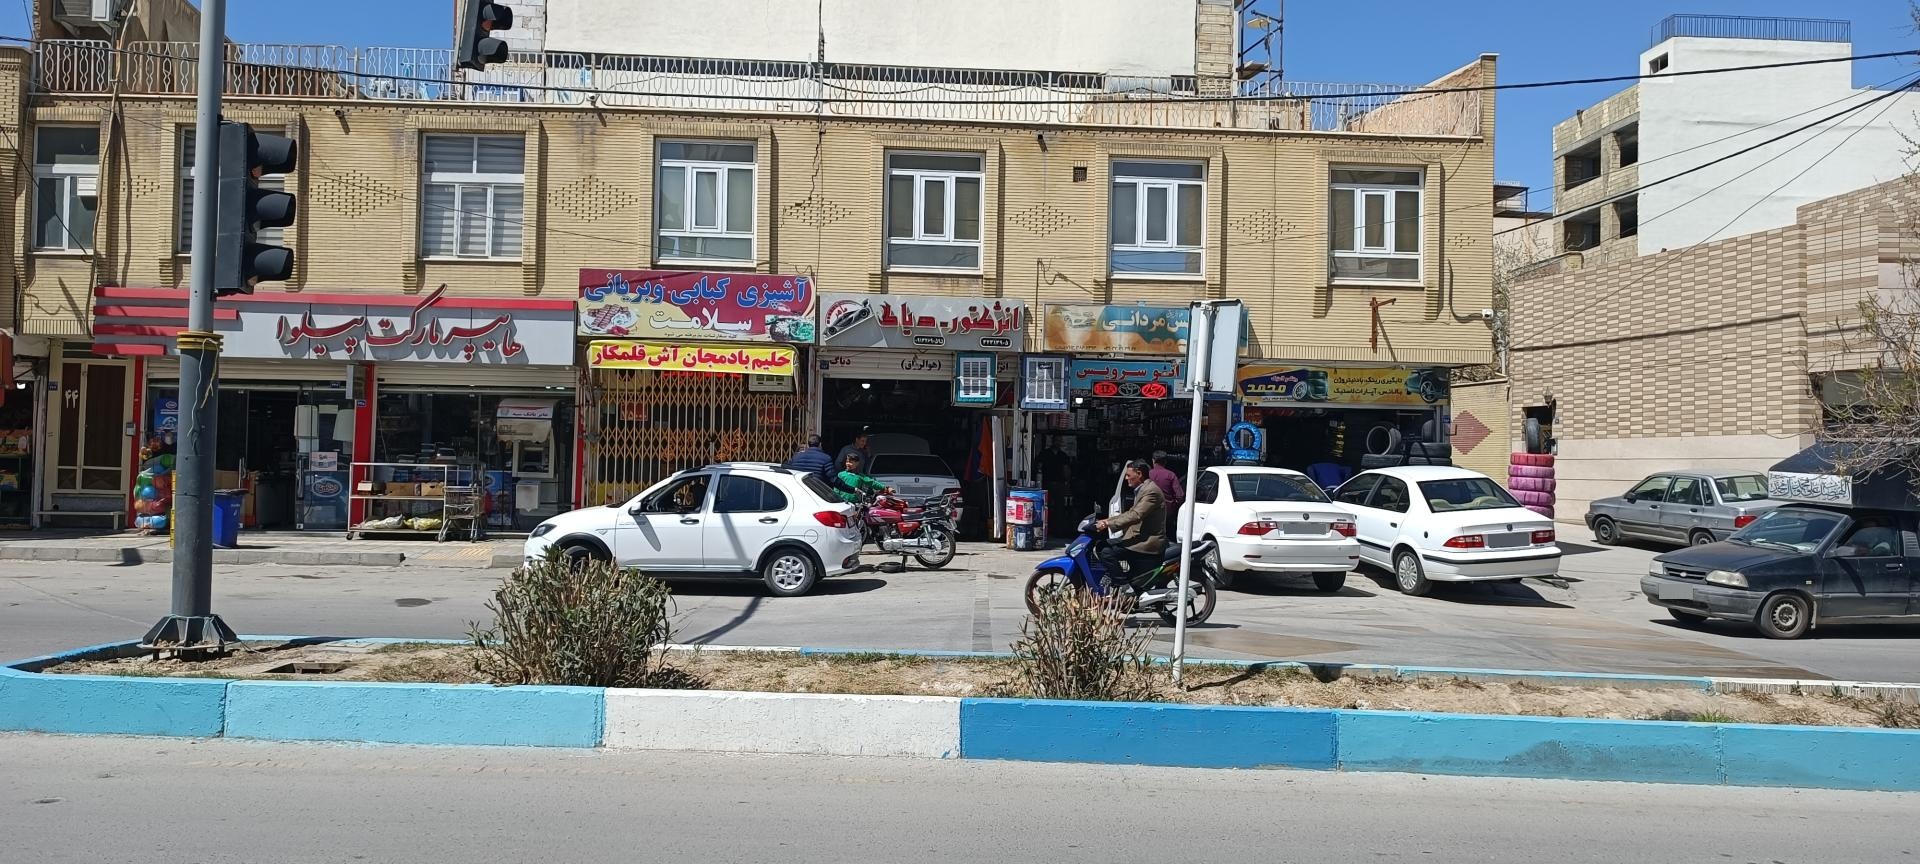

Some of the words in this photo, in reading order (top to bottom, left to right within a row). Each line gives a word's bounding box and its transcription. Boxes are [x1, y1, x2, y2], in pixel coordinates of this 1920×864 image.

[671, 276, 731, 305] کبابی
[737, 277, 809, 309] آشپزی
[365, 283, 447, 347] مارکت
[648, 307, 752, 331] سلامت
[879, 301, 937, 335] دیاگ
[949, 301, 1021, 335] انژکتور
[1102, 311, 1166, 332] مردانی
[592, 345, 647, 365] قلمکار
[648, 345, 680, 368] آش
[683, 348, 751, 370] بادمجان
[752, 351, 791, 371] حلیم
[1076, 366, 1147, 381] سرویس
[1246, 384, 1287, 393] محمد
